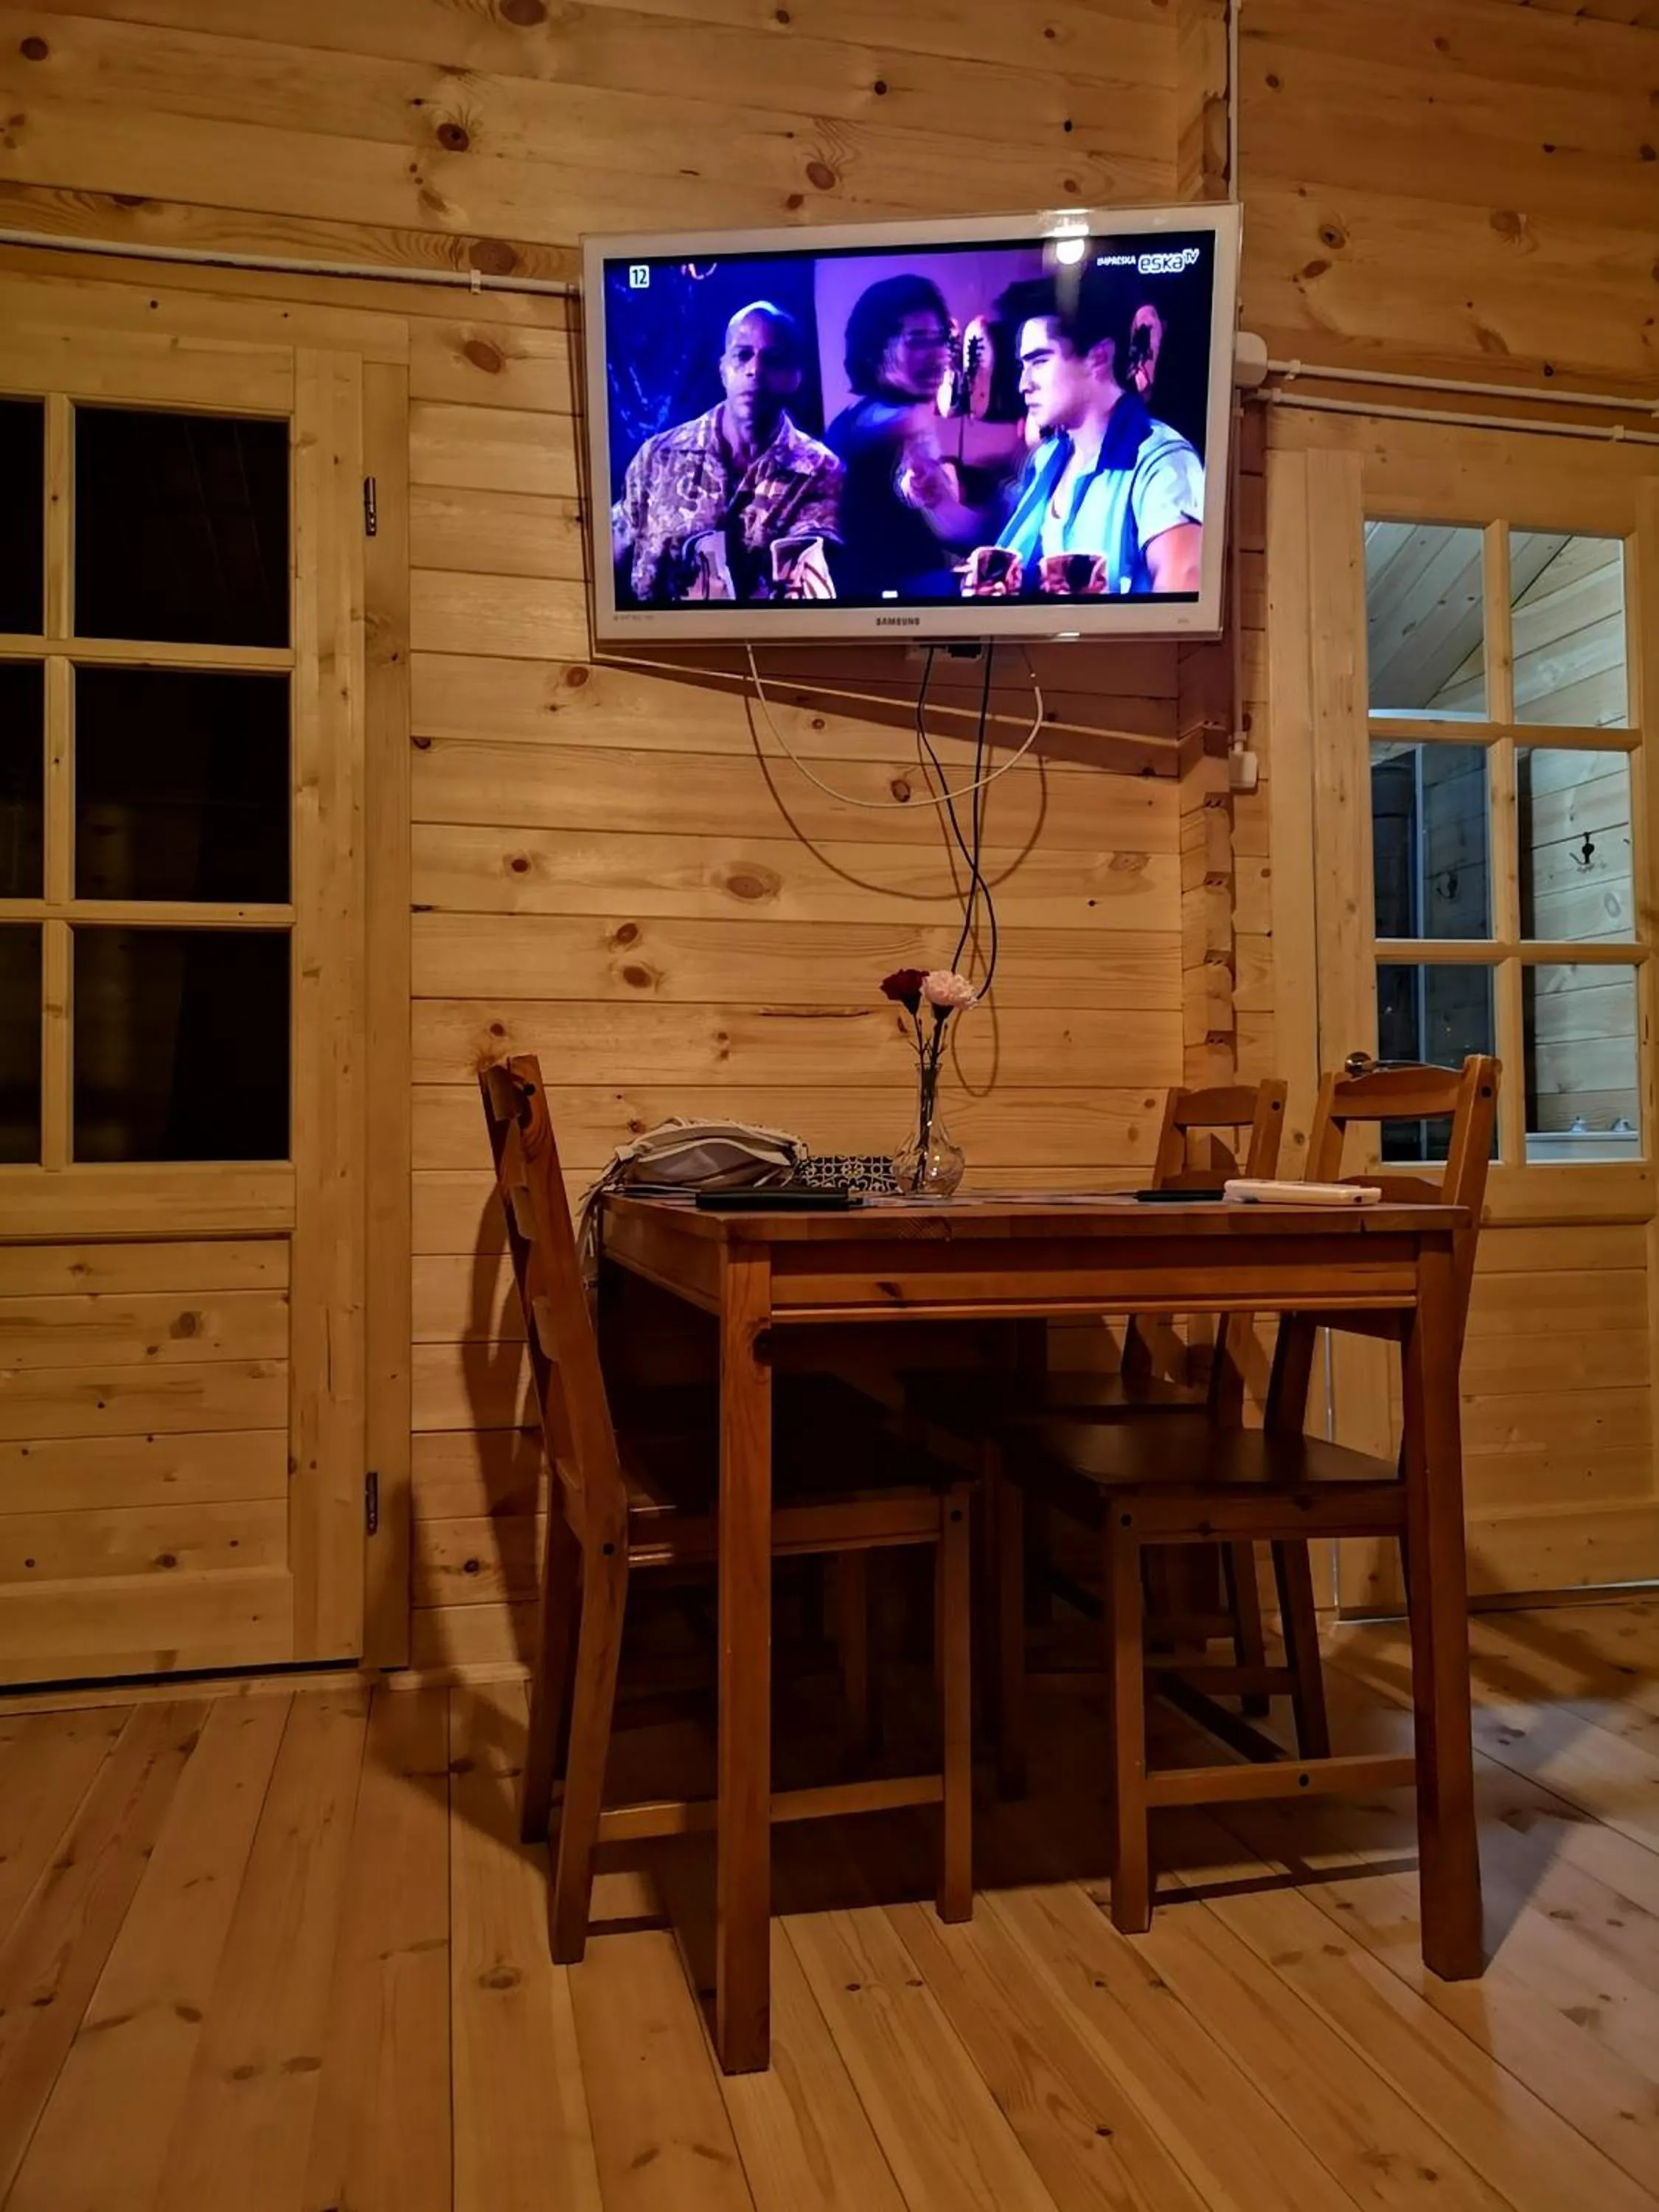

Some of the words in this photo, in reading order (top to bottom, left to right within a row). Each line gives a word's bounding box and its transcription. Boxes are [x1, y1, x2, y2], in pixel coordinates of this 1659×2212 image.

[1139, 254, 1184, 273] eska
[632, 268, 648, 286] 12
[876, 616, 920, 626] SAMSUNG
